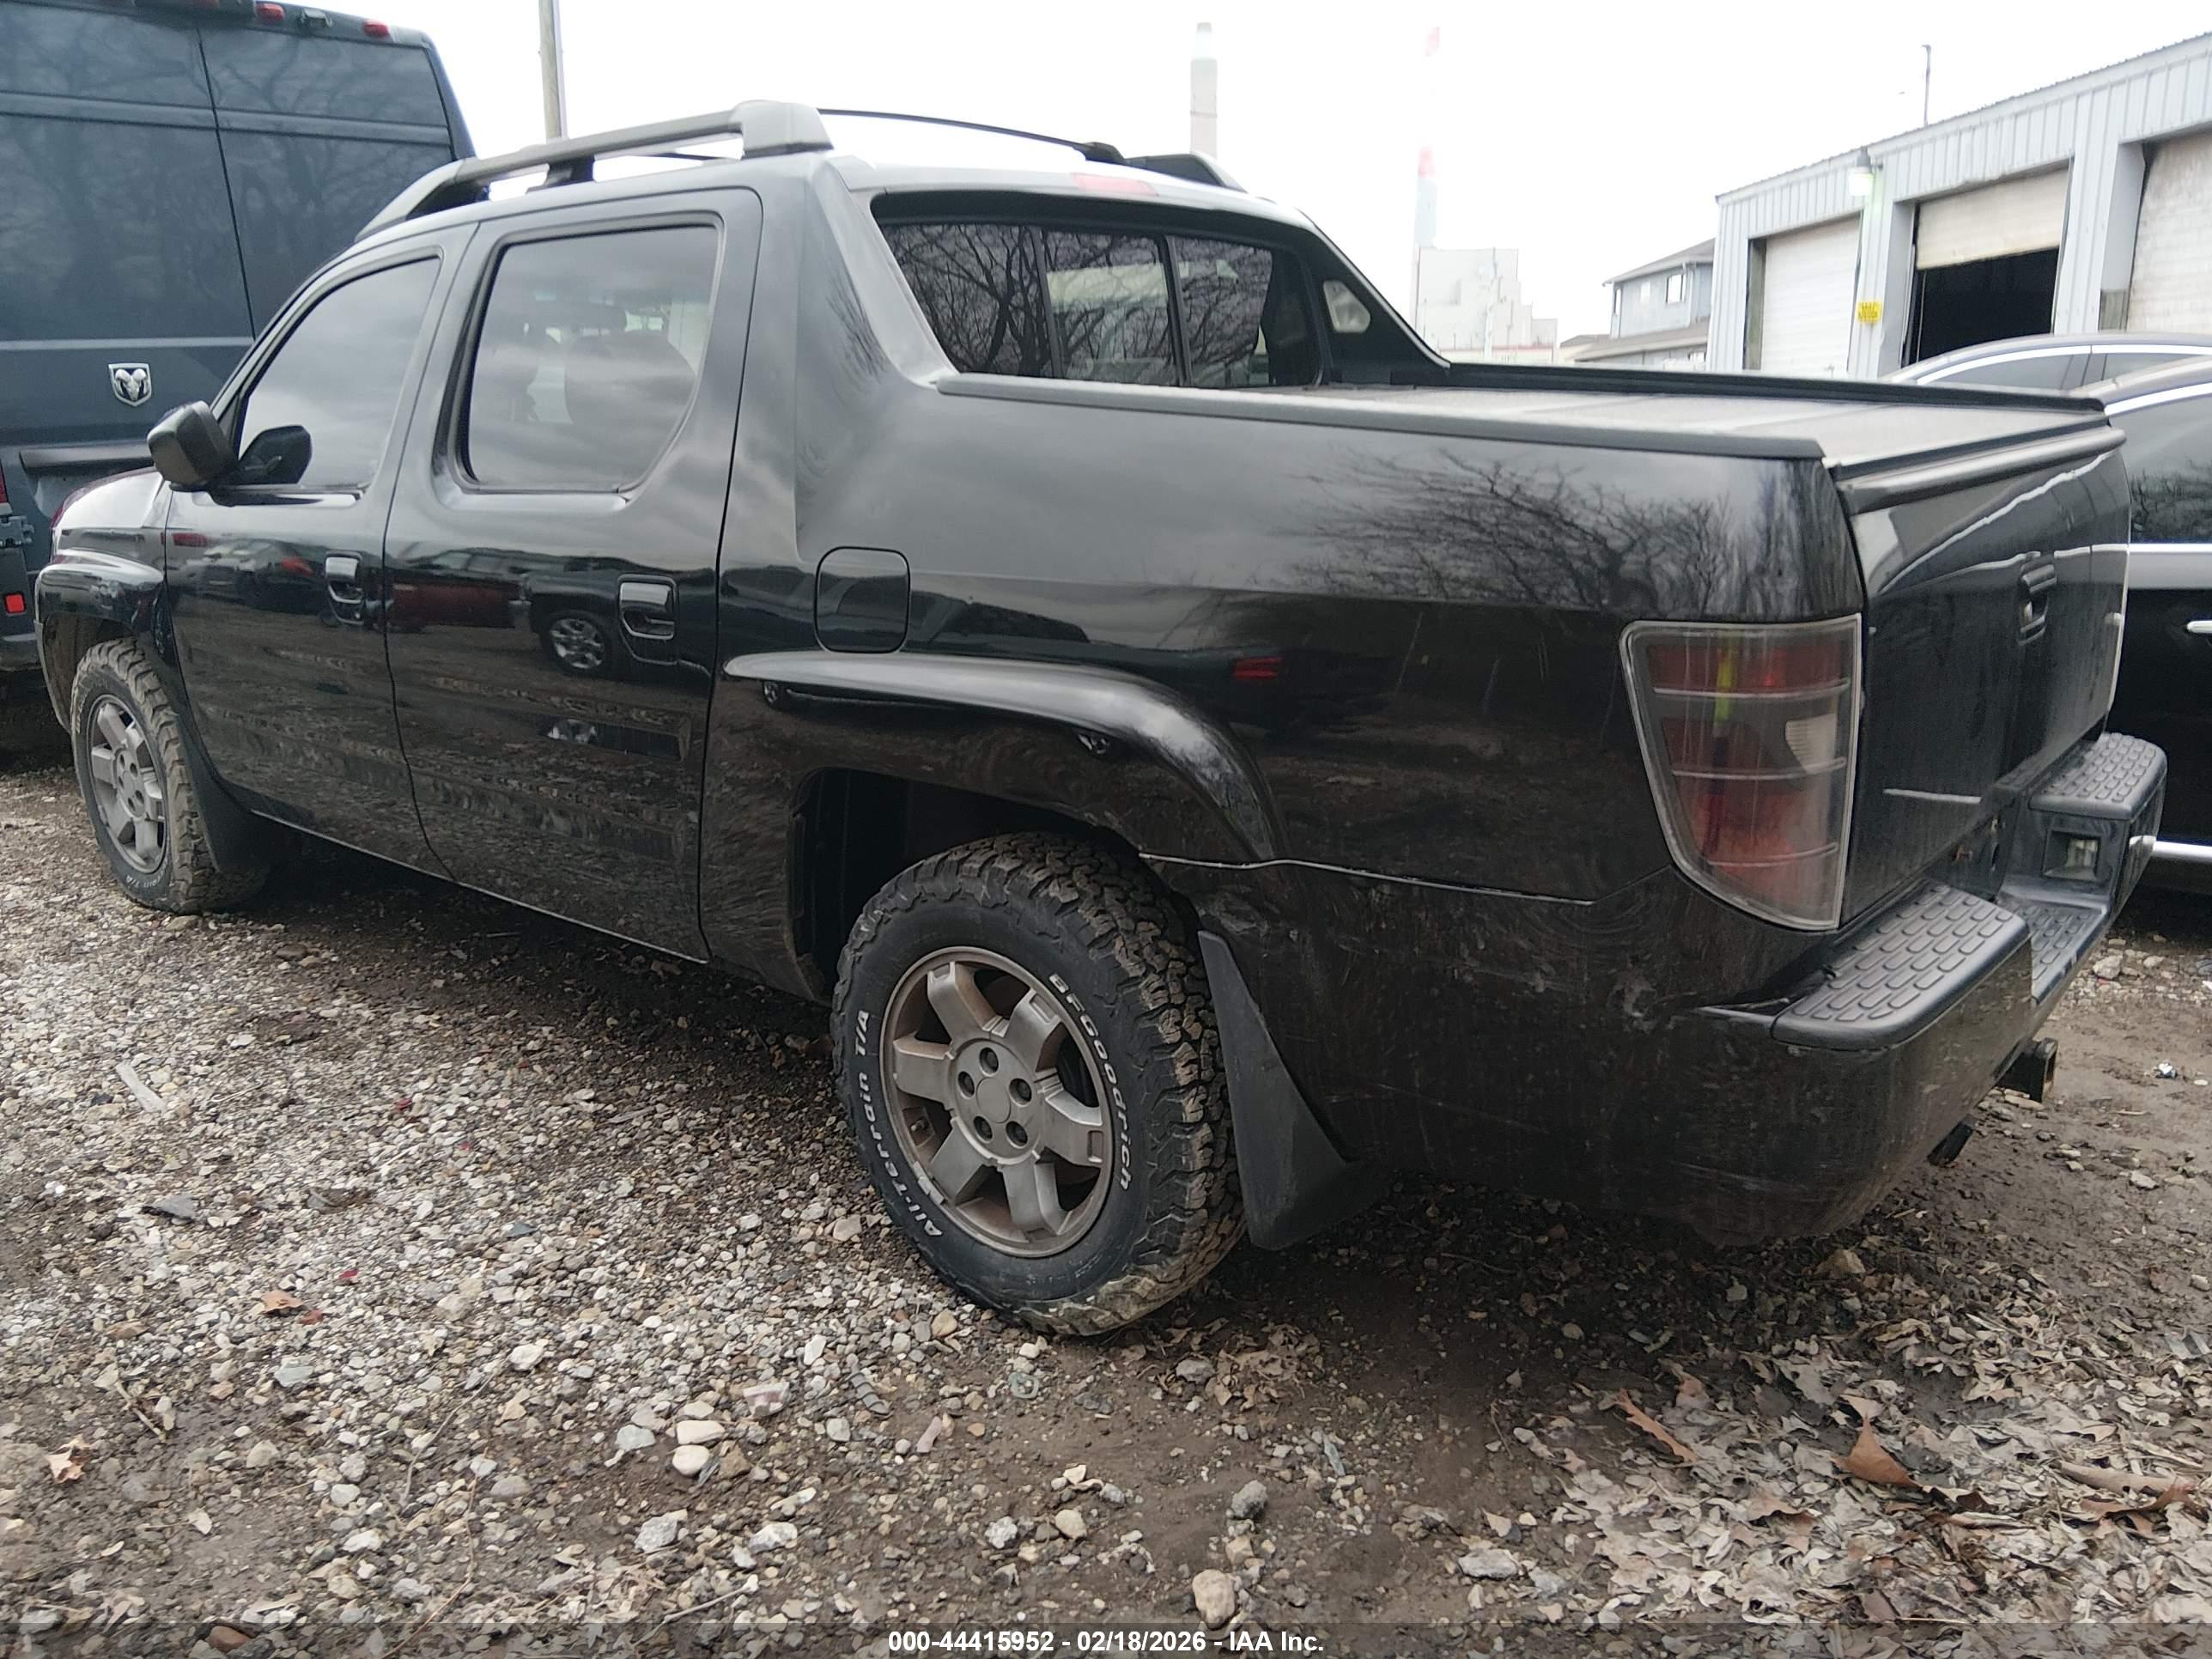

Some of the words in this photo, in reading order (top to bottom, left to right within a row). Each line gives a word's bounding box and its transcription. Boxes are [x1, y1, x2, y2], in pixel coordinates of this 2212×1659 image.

[854, 1009, 870, 1056] T/A
[1048, 973, 1132, 1191] BFGoodrich
[859, 1072, 943, 1237] All-Terrain
